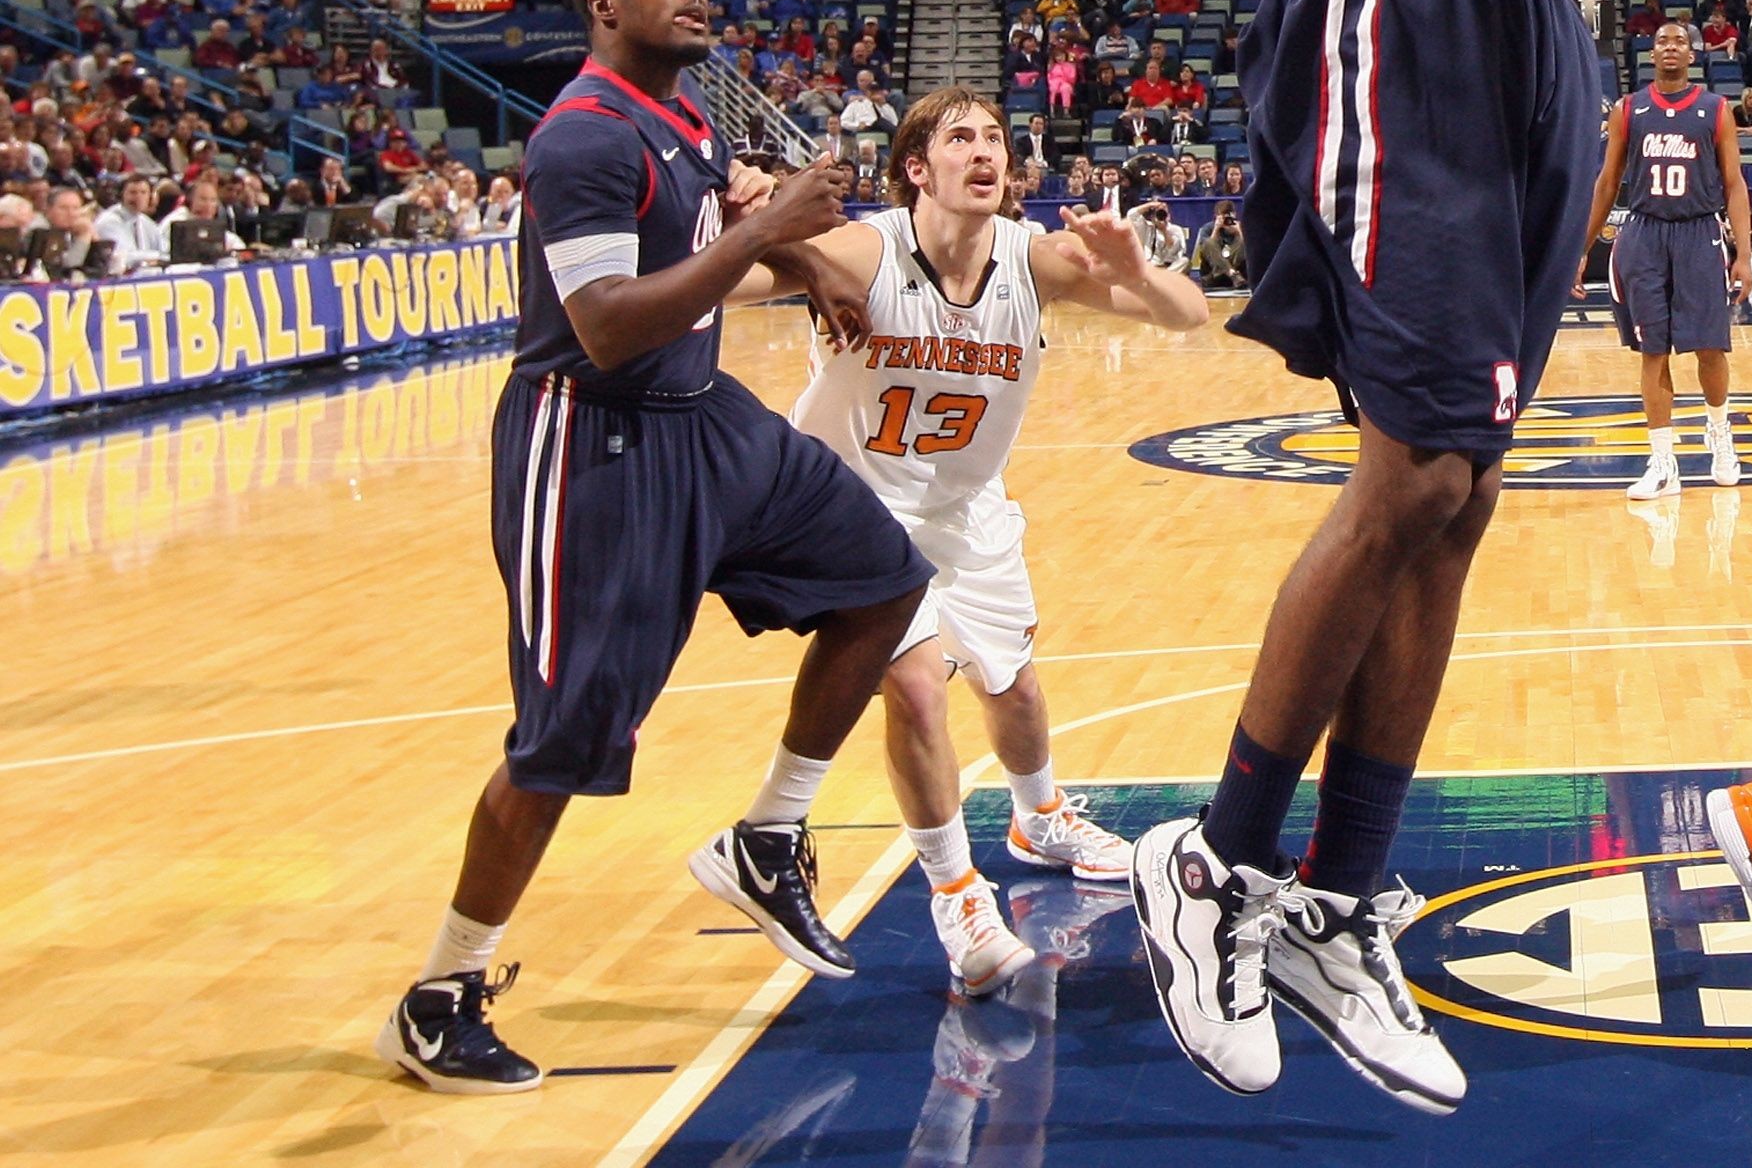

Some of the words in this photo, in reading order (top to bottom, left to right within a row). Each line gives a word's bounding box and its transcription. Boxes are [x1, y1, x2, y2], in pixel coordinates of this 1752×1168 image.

[1642, 133, 1663, 159] Ole
[1663, 134, 1698, 160] Miss
[1650, 164, 1686, 197] 10
[0, 264, 326, 409] SKETBALL
[865, 335, 1024, 382] TENNESSEE
[865, 385, 989, 457] 13
